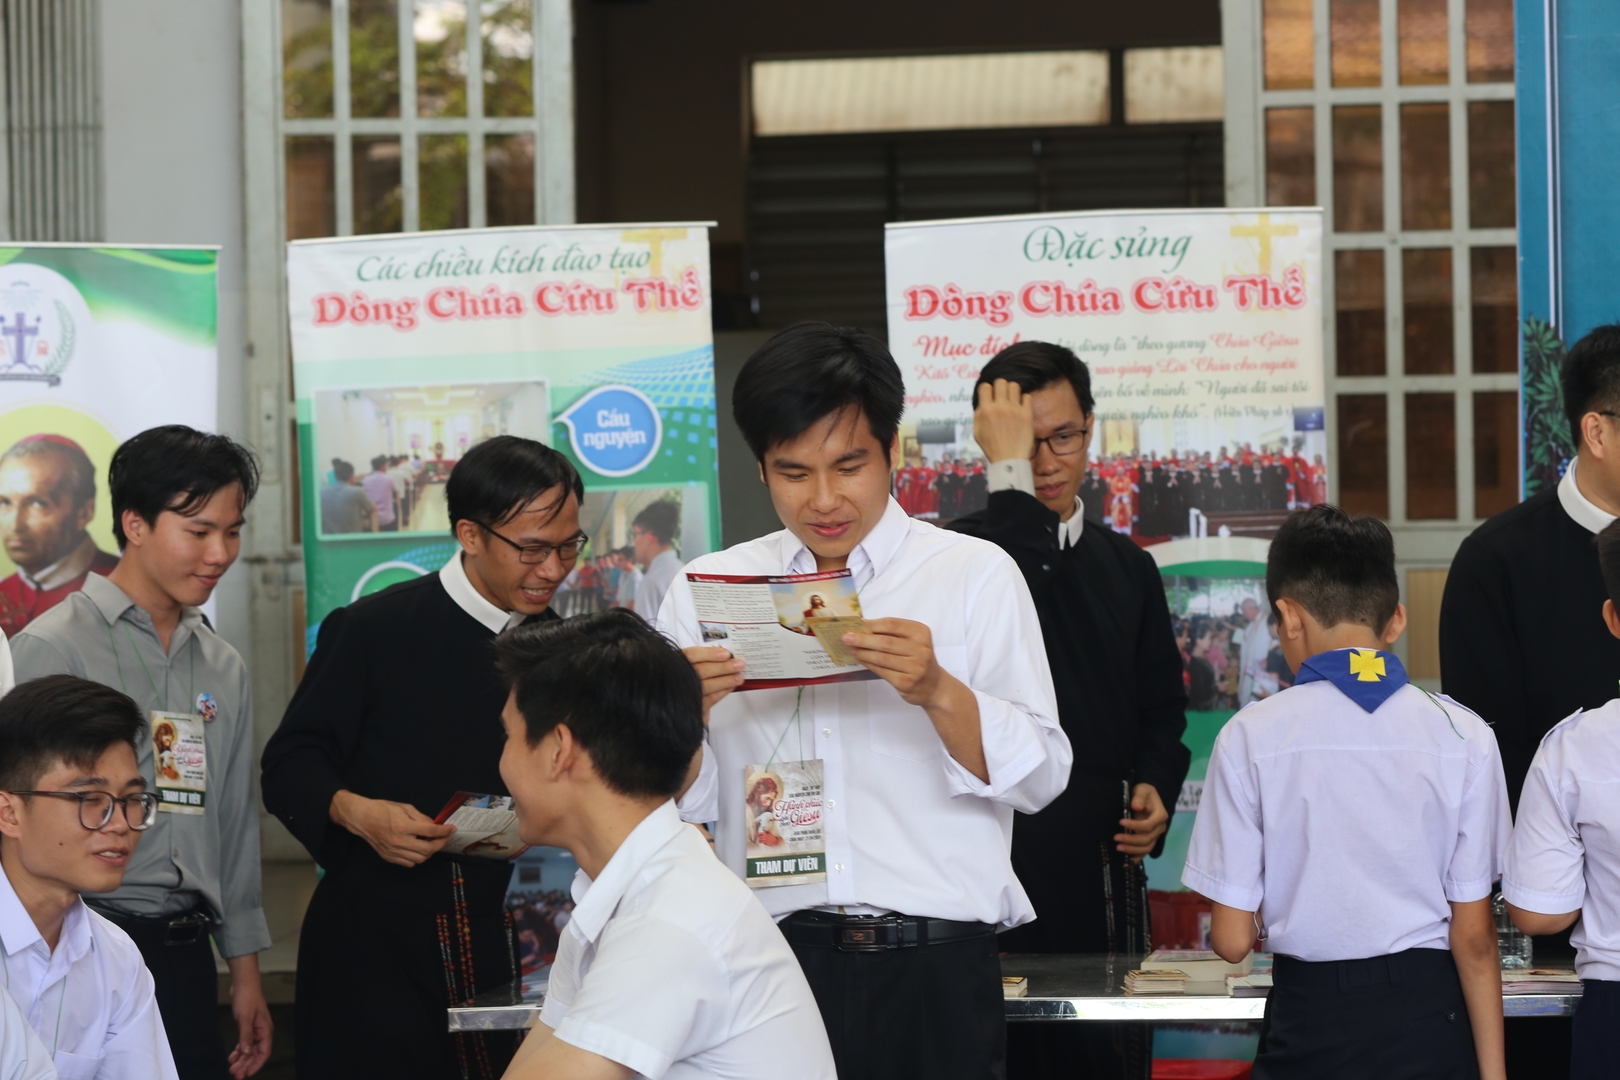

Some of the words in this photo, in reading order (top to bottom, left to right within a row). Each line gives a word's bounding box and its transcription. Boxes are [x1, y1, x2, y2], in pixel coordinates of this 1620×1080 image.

[356, 254, 408, 282] Các
[413, 245, 484, 279] chiều
[488, 243, 546, 275] kích
[552, 243, 602, 272] đào
[609, 246, 653, 275] tạo
[1022, 224, 1105, 268] Đặc
[1109, 225, 1194, 274] sủng
[313, 290, 419, 332] Dòng
[424, 284, 526, 322] Chúa
[533, 281, 617, 316] Cứu
[623, 267, 702, 312] Thế
[905, 284, 1013, 326] Dòng
[1018, 279, 1125, 318] Chúa
[1131, 277, 1218, 313] Cứu
[1224, 266, 1306, 310] Thế
[582, 428, 647, 450] nguyện
[754, 860, 782, 875] THAM
[782, 858, 797, 874] DỰ
[797, 854, 819, 871] VIÊN
